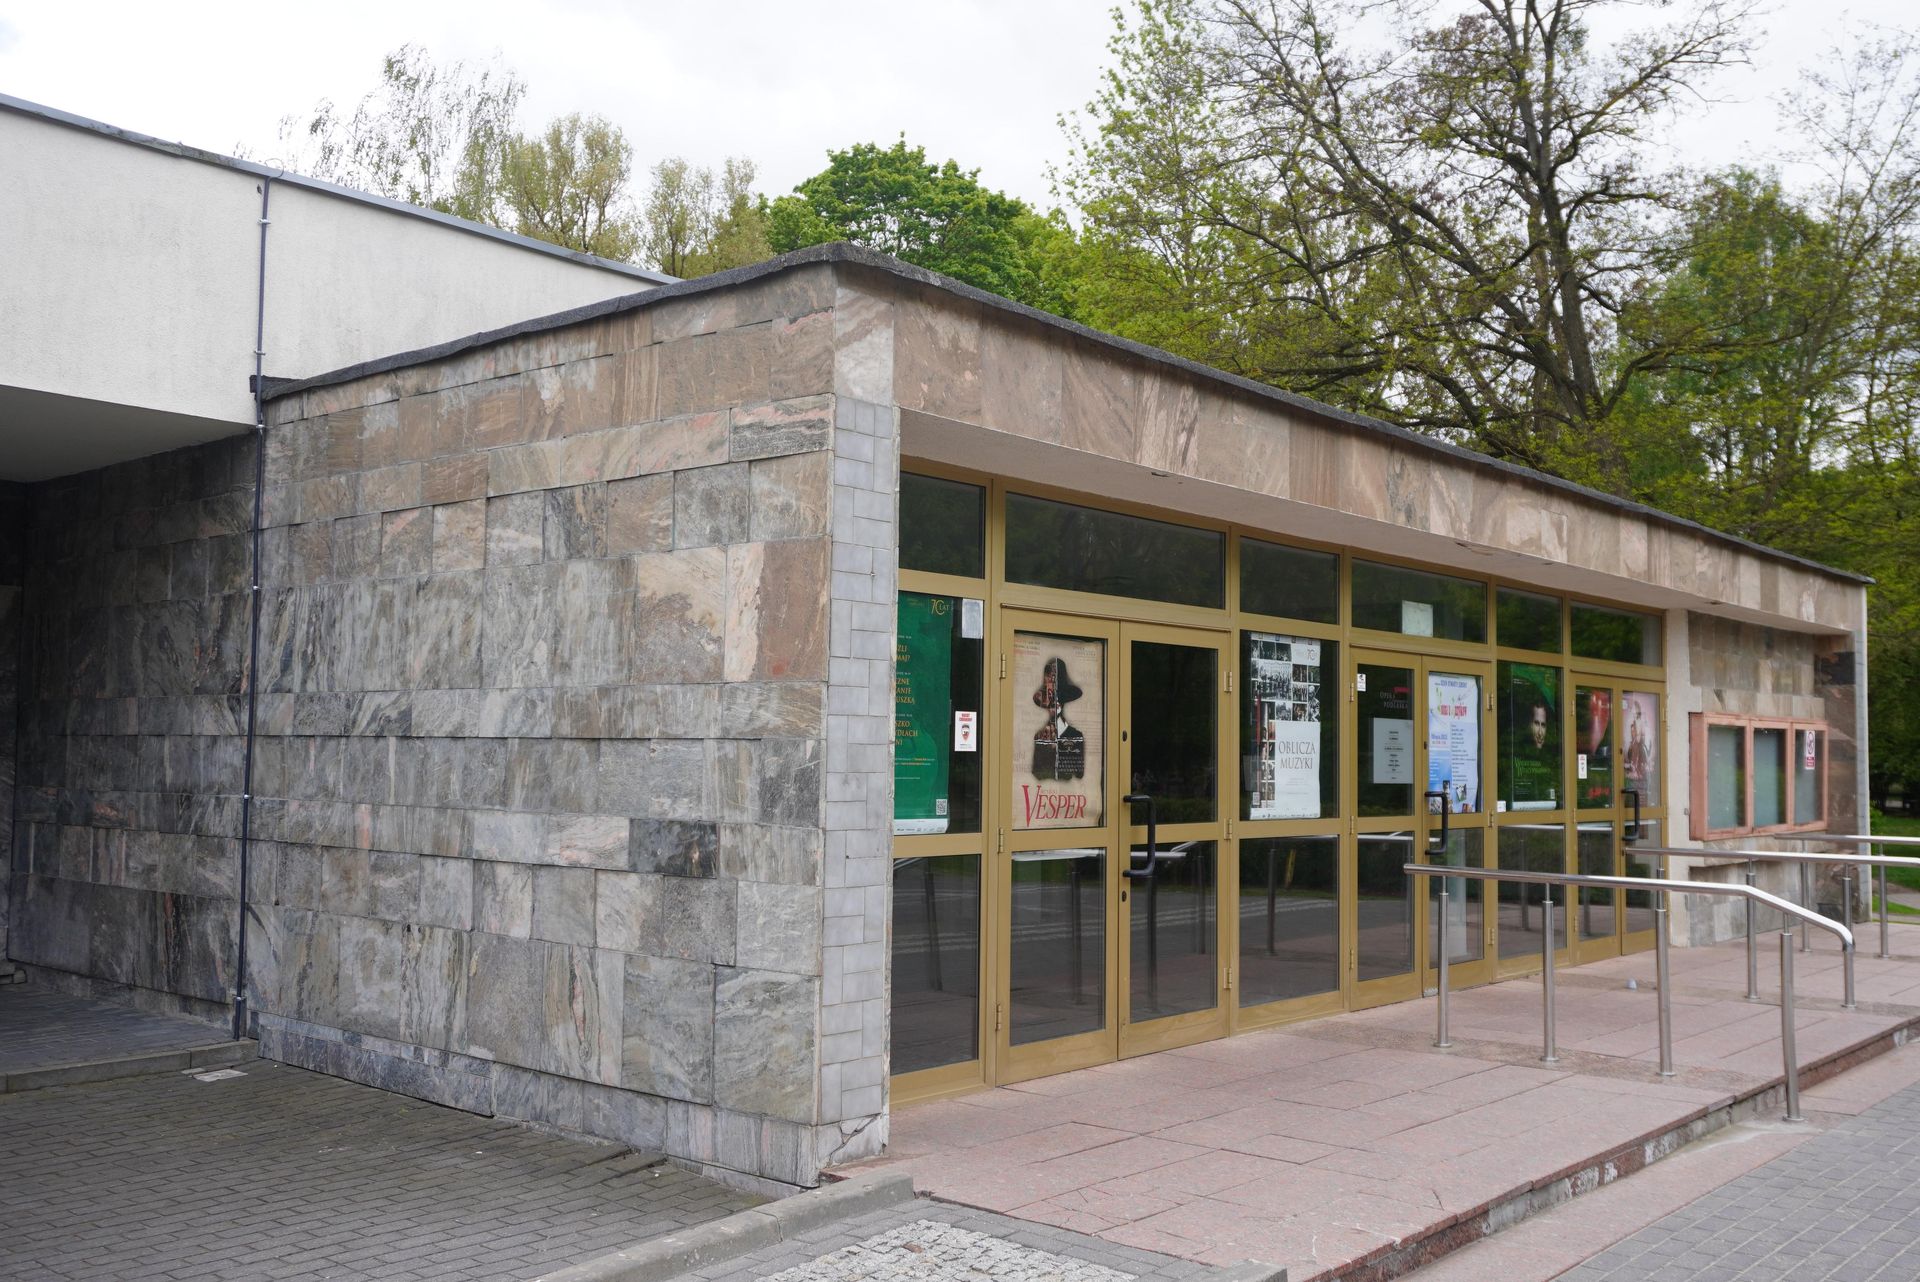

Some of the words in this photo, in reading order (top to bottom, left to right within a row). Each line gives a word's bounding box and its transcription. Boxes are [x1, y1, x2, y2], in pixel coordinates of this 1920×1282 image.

[1278, 740, 1316, 755] OBLICZA
[1280, 756, 1313, 770] MUZYKI
[1022, 784, 1087, 827] VESPER
